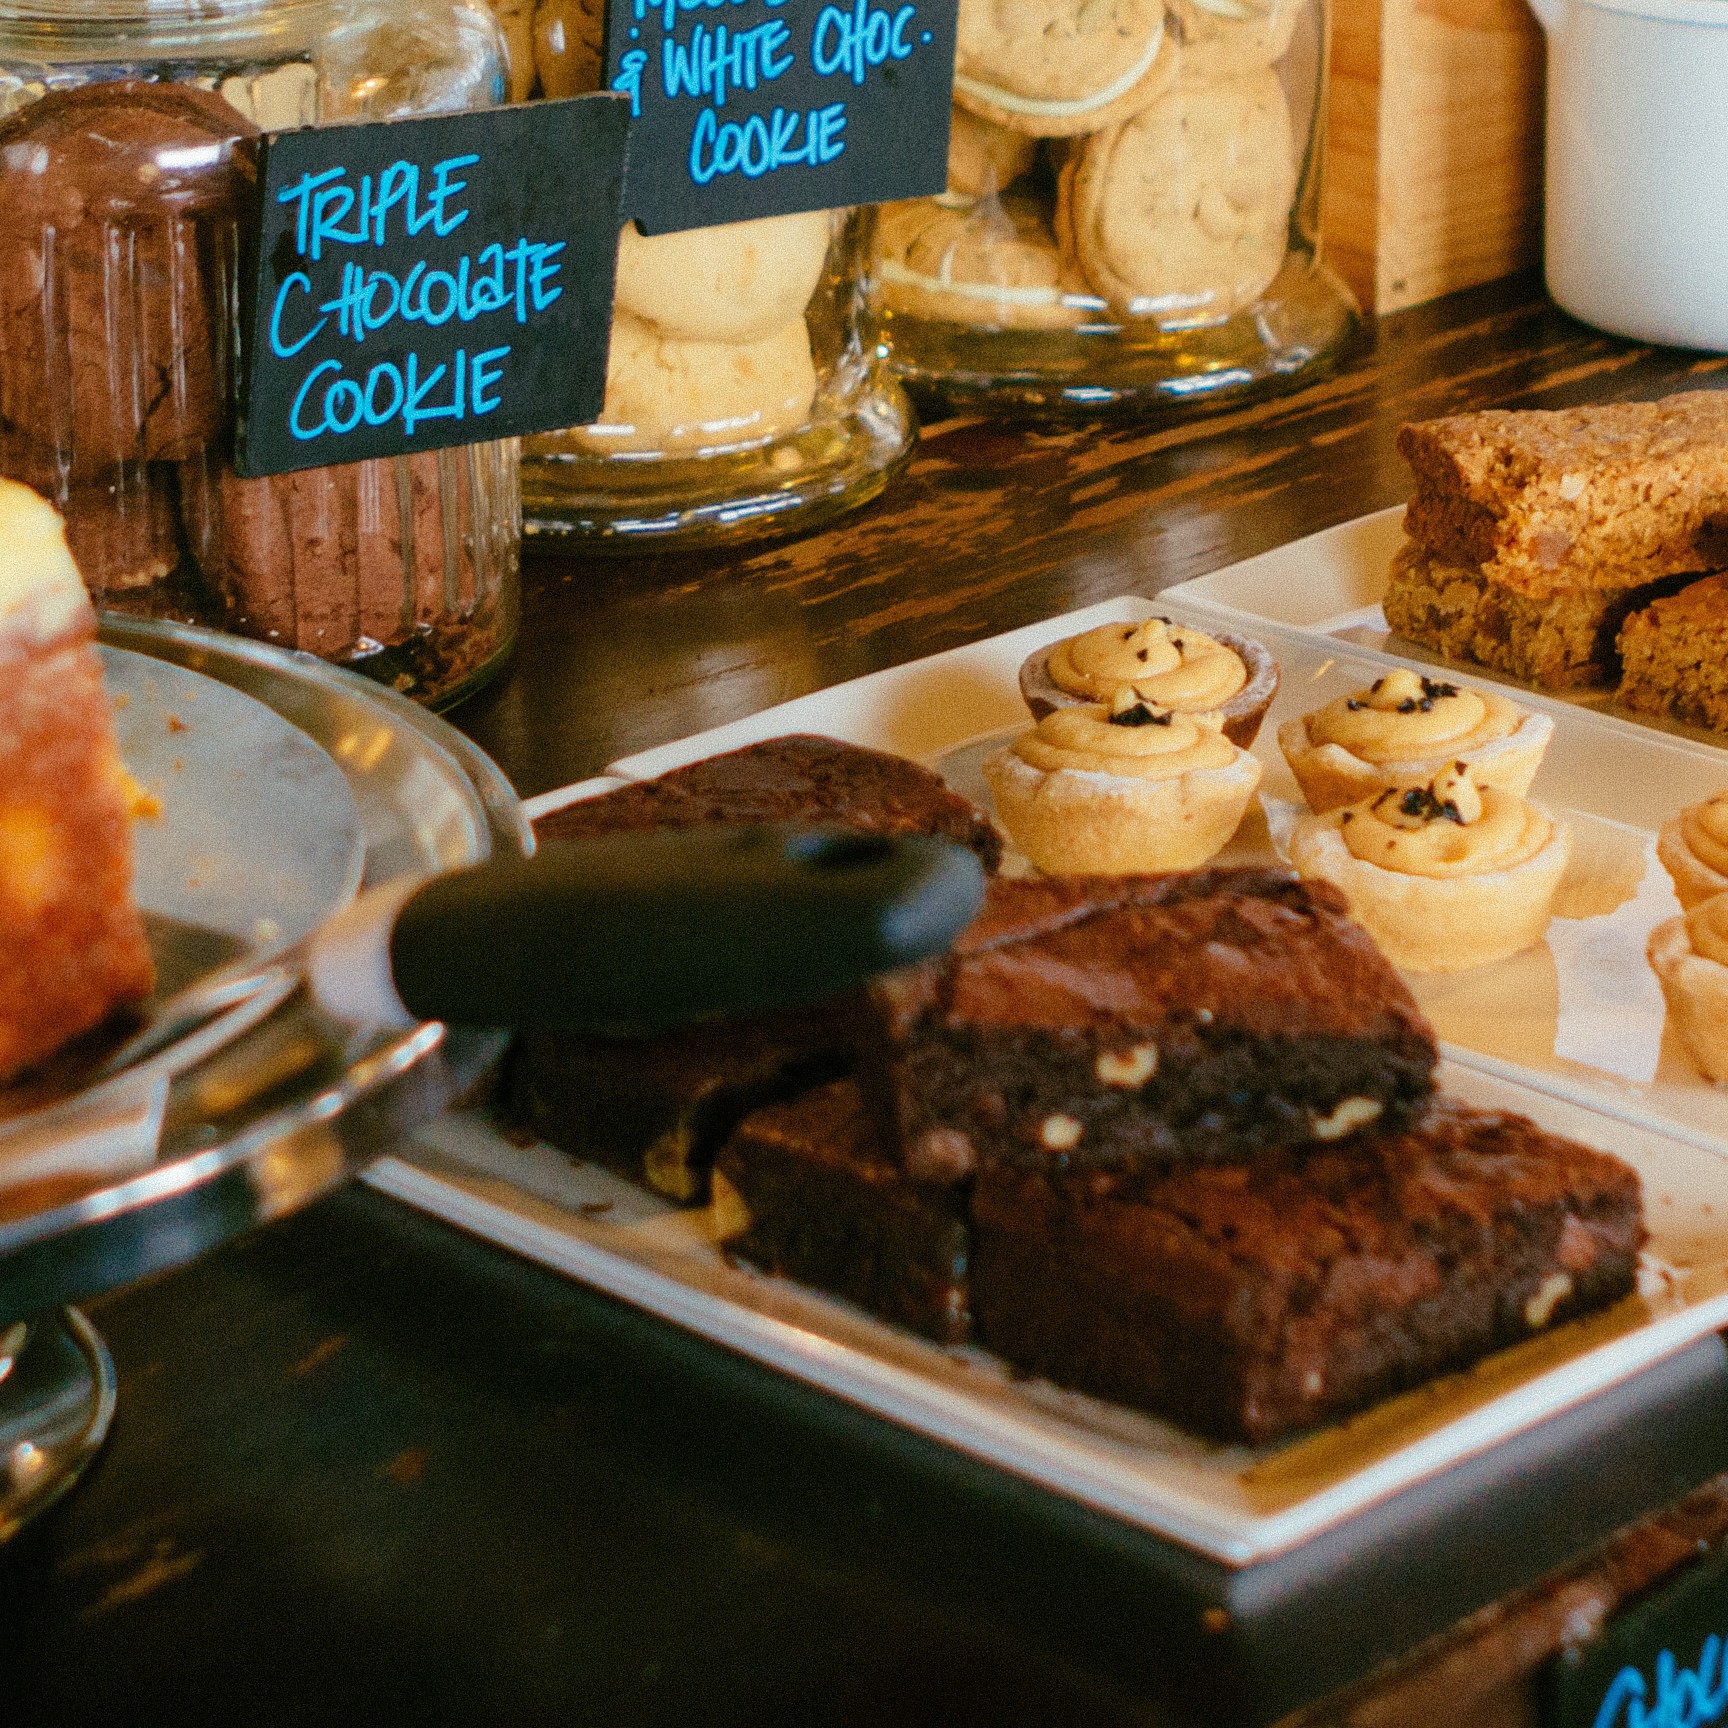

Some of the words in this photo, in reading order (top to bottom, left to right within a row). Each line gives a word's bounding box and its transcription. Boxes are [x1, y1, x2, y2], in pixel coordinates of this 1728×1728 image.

[661, 18, 795, 107] WHITE
[688, 101, 849, 186] COOKIE
[277, 153, 482, 261] TRIPLE
[289, 345, 513, 442] COOKIE
